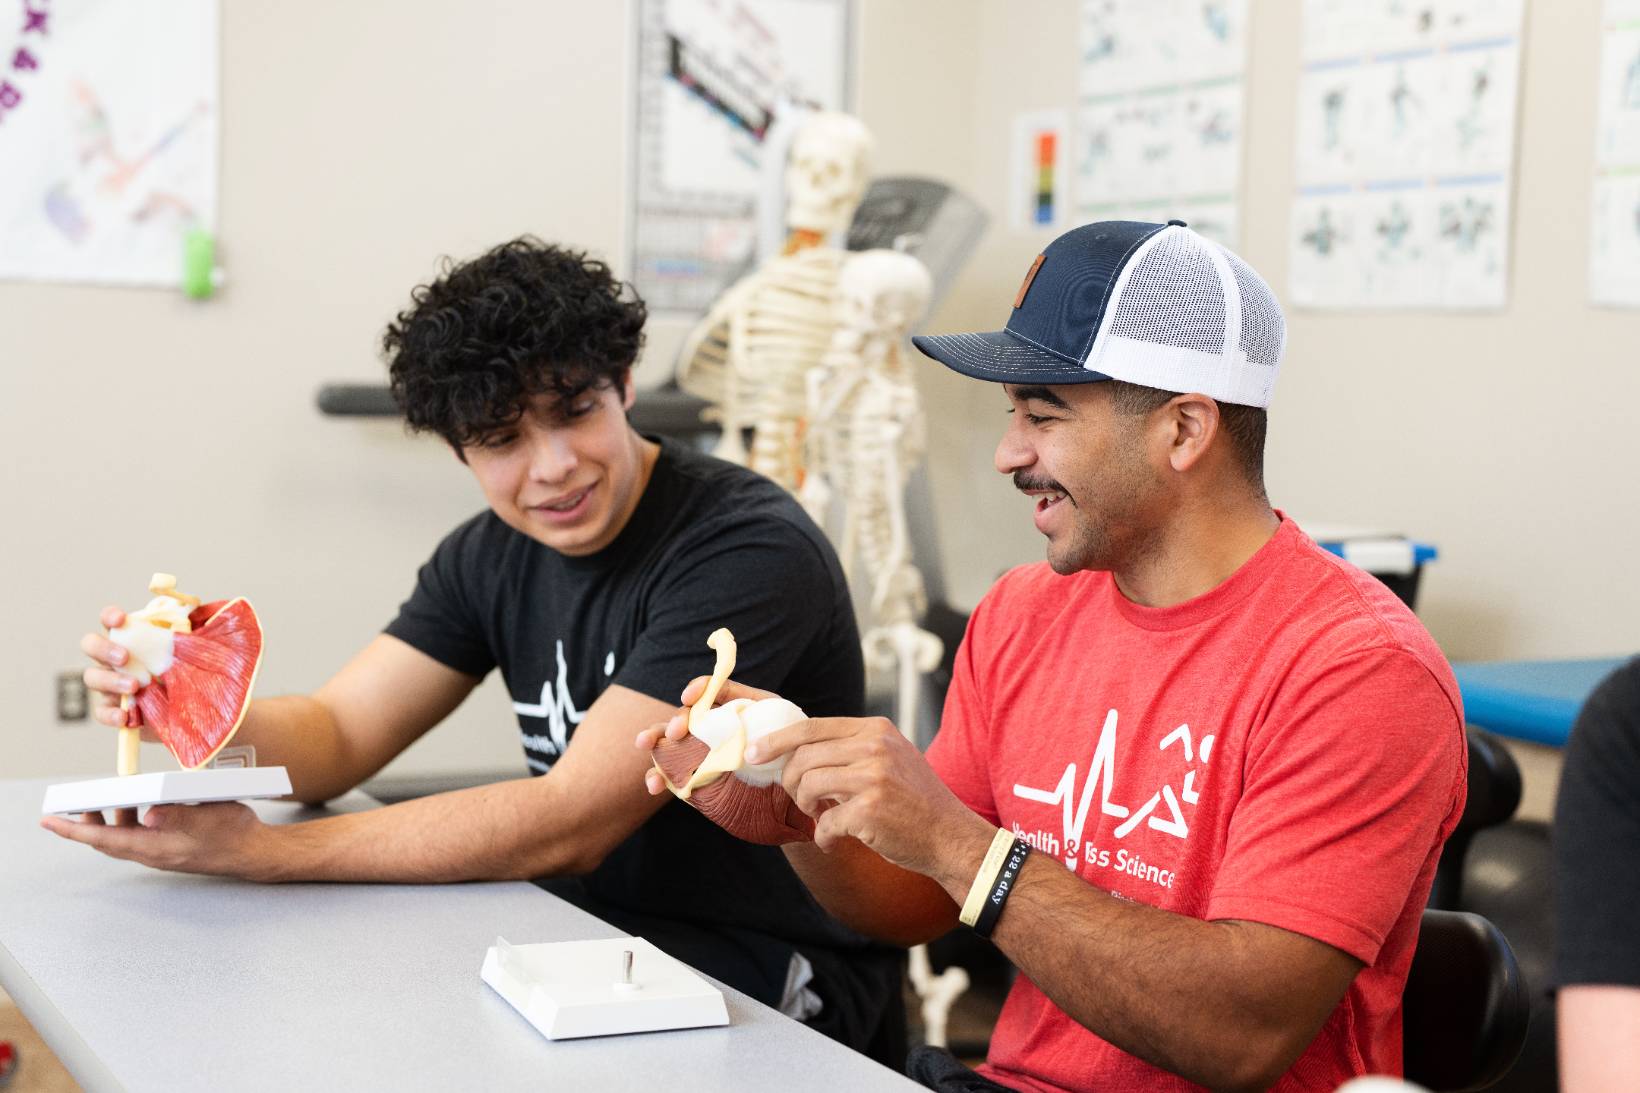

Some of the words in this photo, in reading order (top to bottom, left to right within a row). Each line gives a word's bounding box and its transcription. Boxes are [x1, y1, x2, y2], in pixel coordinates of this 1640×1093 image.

[1008, 855, 1022, 870] 22
[1004, 871, 1012, 879] a
[991, 880, 1009, 905] day
